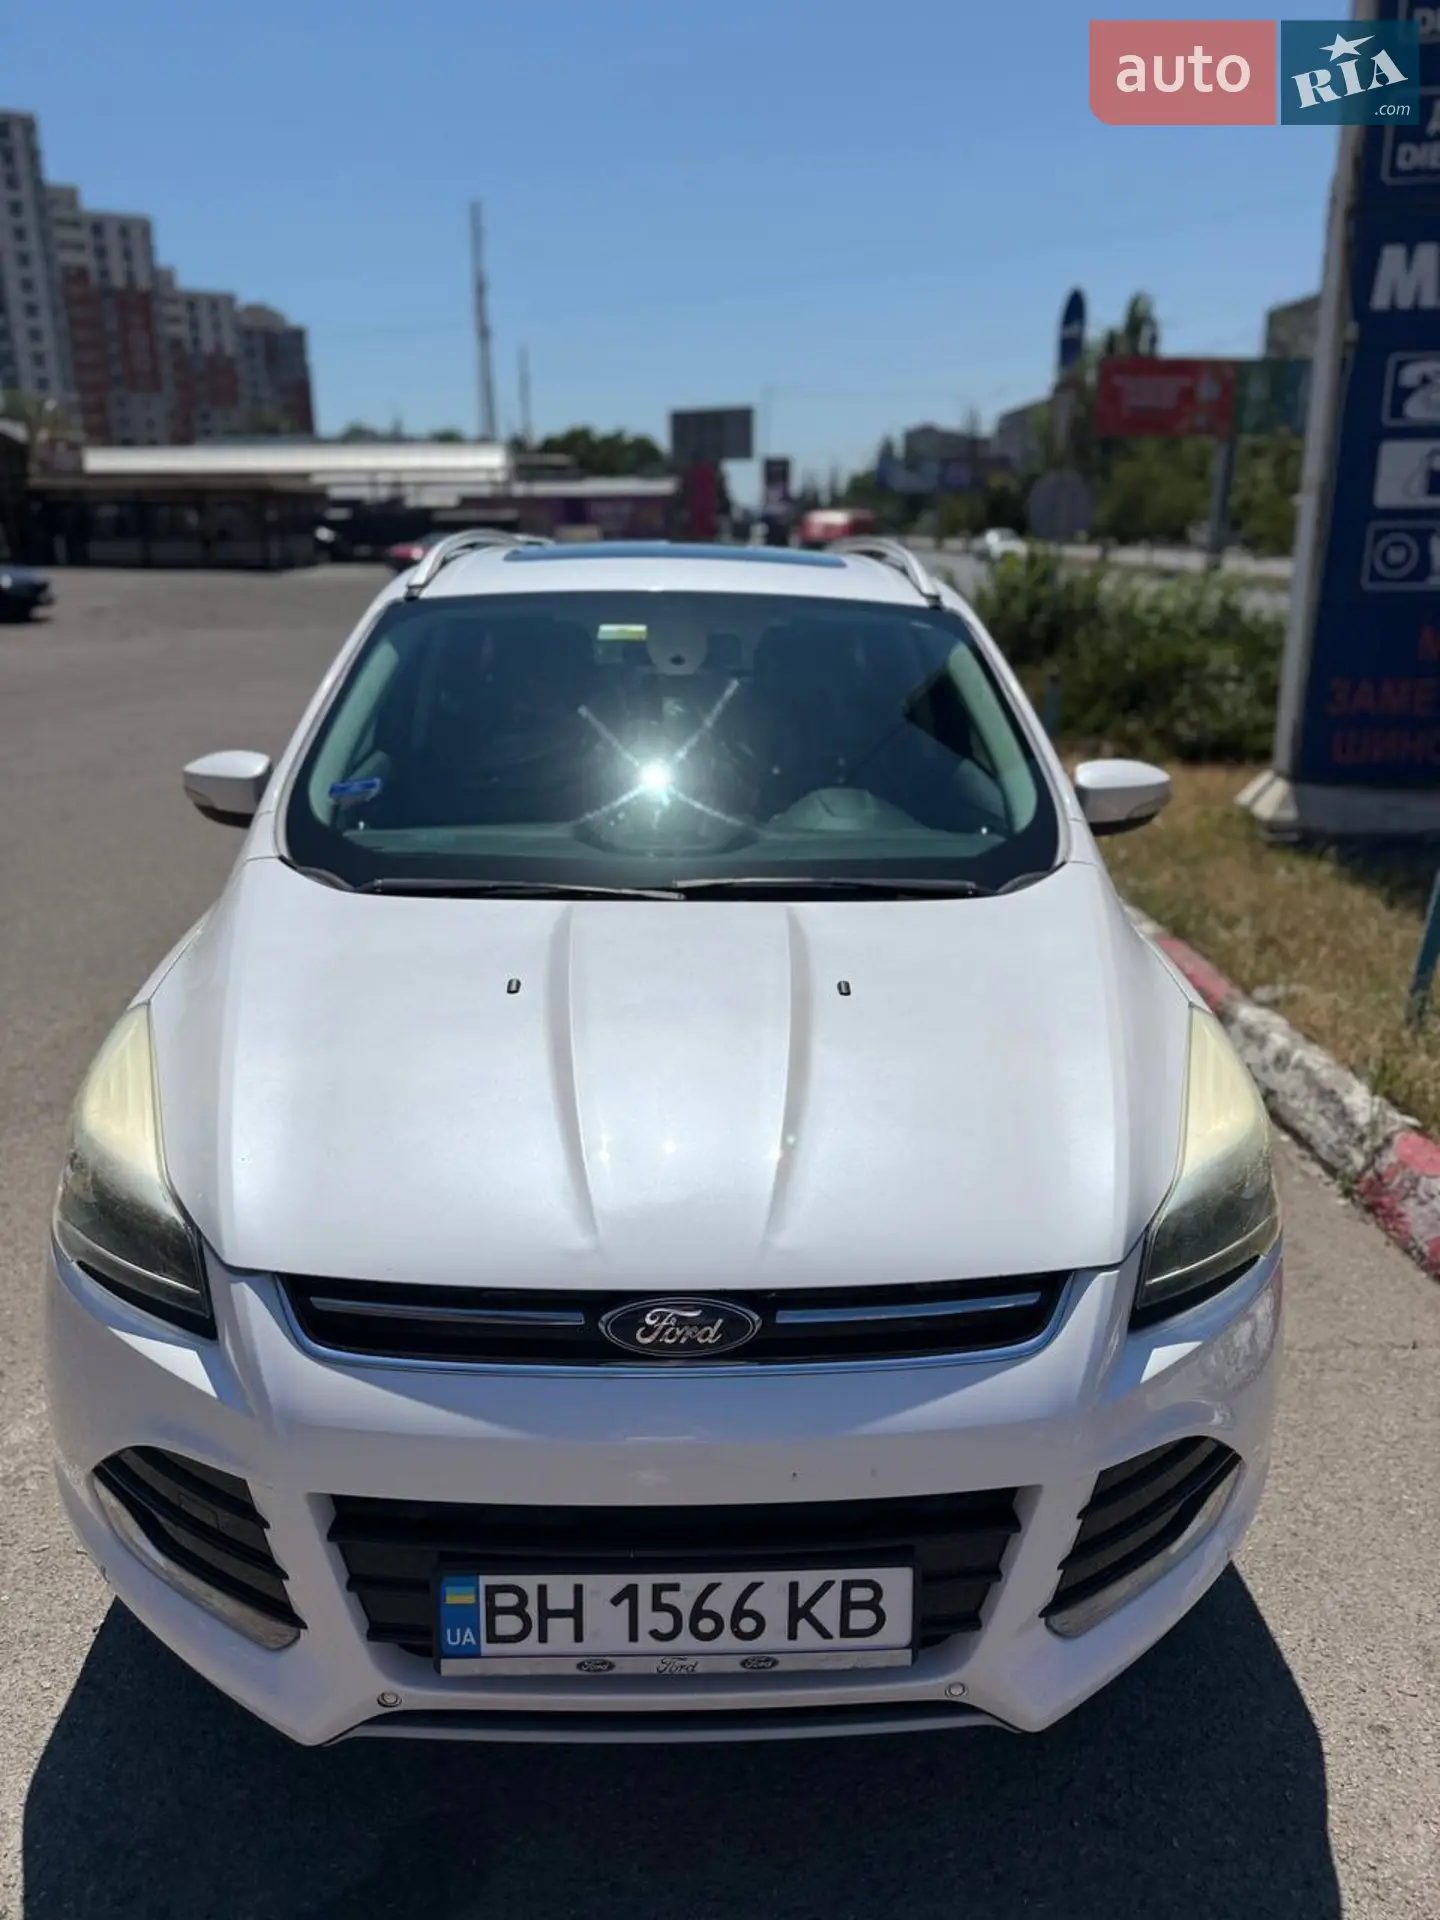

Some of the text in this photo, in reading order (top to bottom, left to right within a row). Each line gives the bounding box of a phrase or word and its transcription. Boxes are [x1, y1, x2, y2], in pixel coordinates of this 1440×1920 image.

[635, 1307, 724, 1345] Ford
[484, 1578, 887, 1645] BH 1566 KB
[446, 1627, 476, 1647] UA
[581, 1655, 774, 1675] Ford Ford Ford
